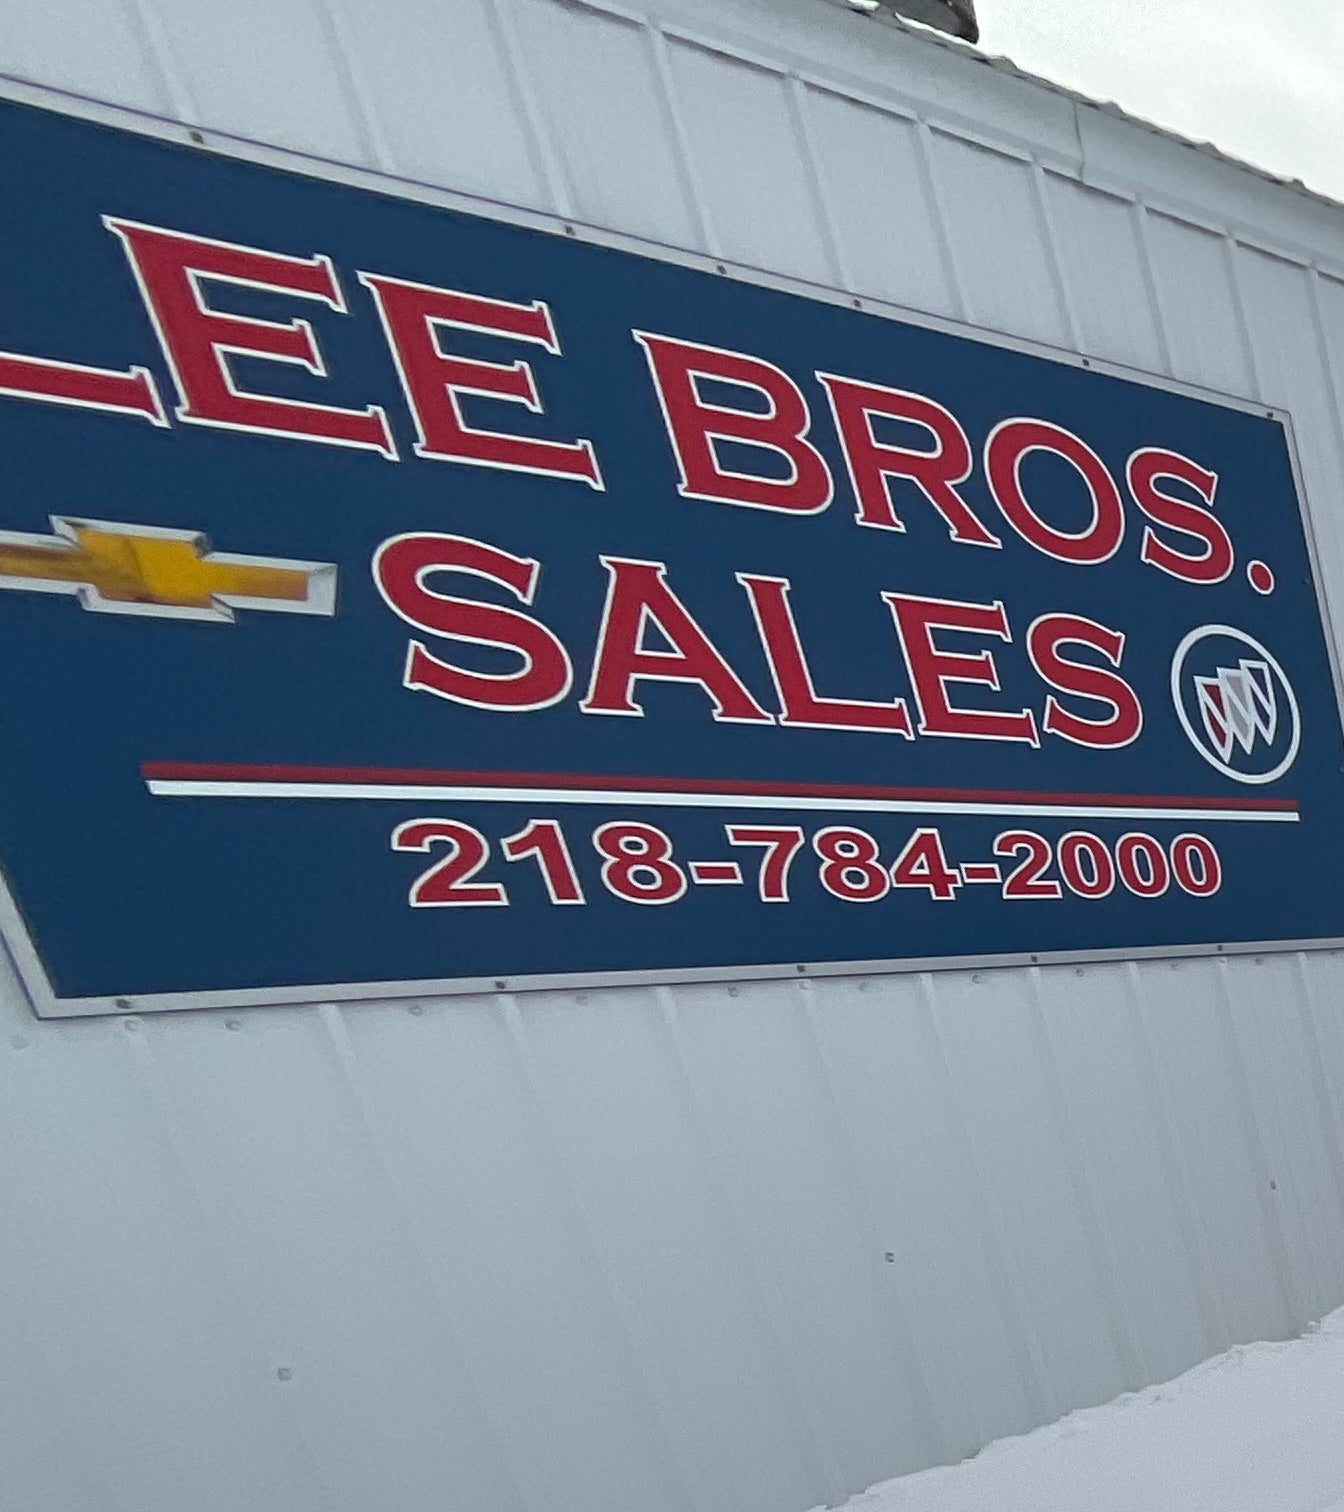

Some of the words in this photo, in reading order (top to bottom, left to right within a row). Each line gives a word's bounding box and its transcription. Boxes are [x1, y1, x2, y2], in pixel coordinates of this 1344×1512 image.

[633, 330, 1275, 597] BROS.
[372, 533, 1144, 749] SALES
[391, 819, 1223, 907] 218-784-2000
